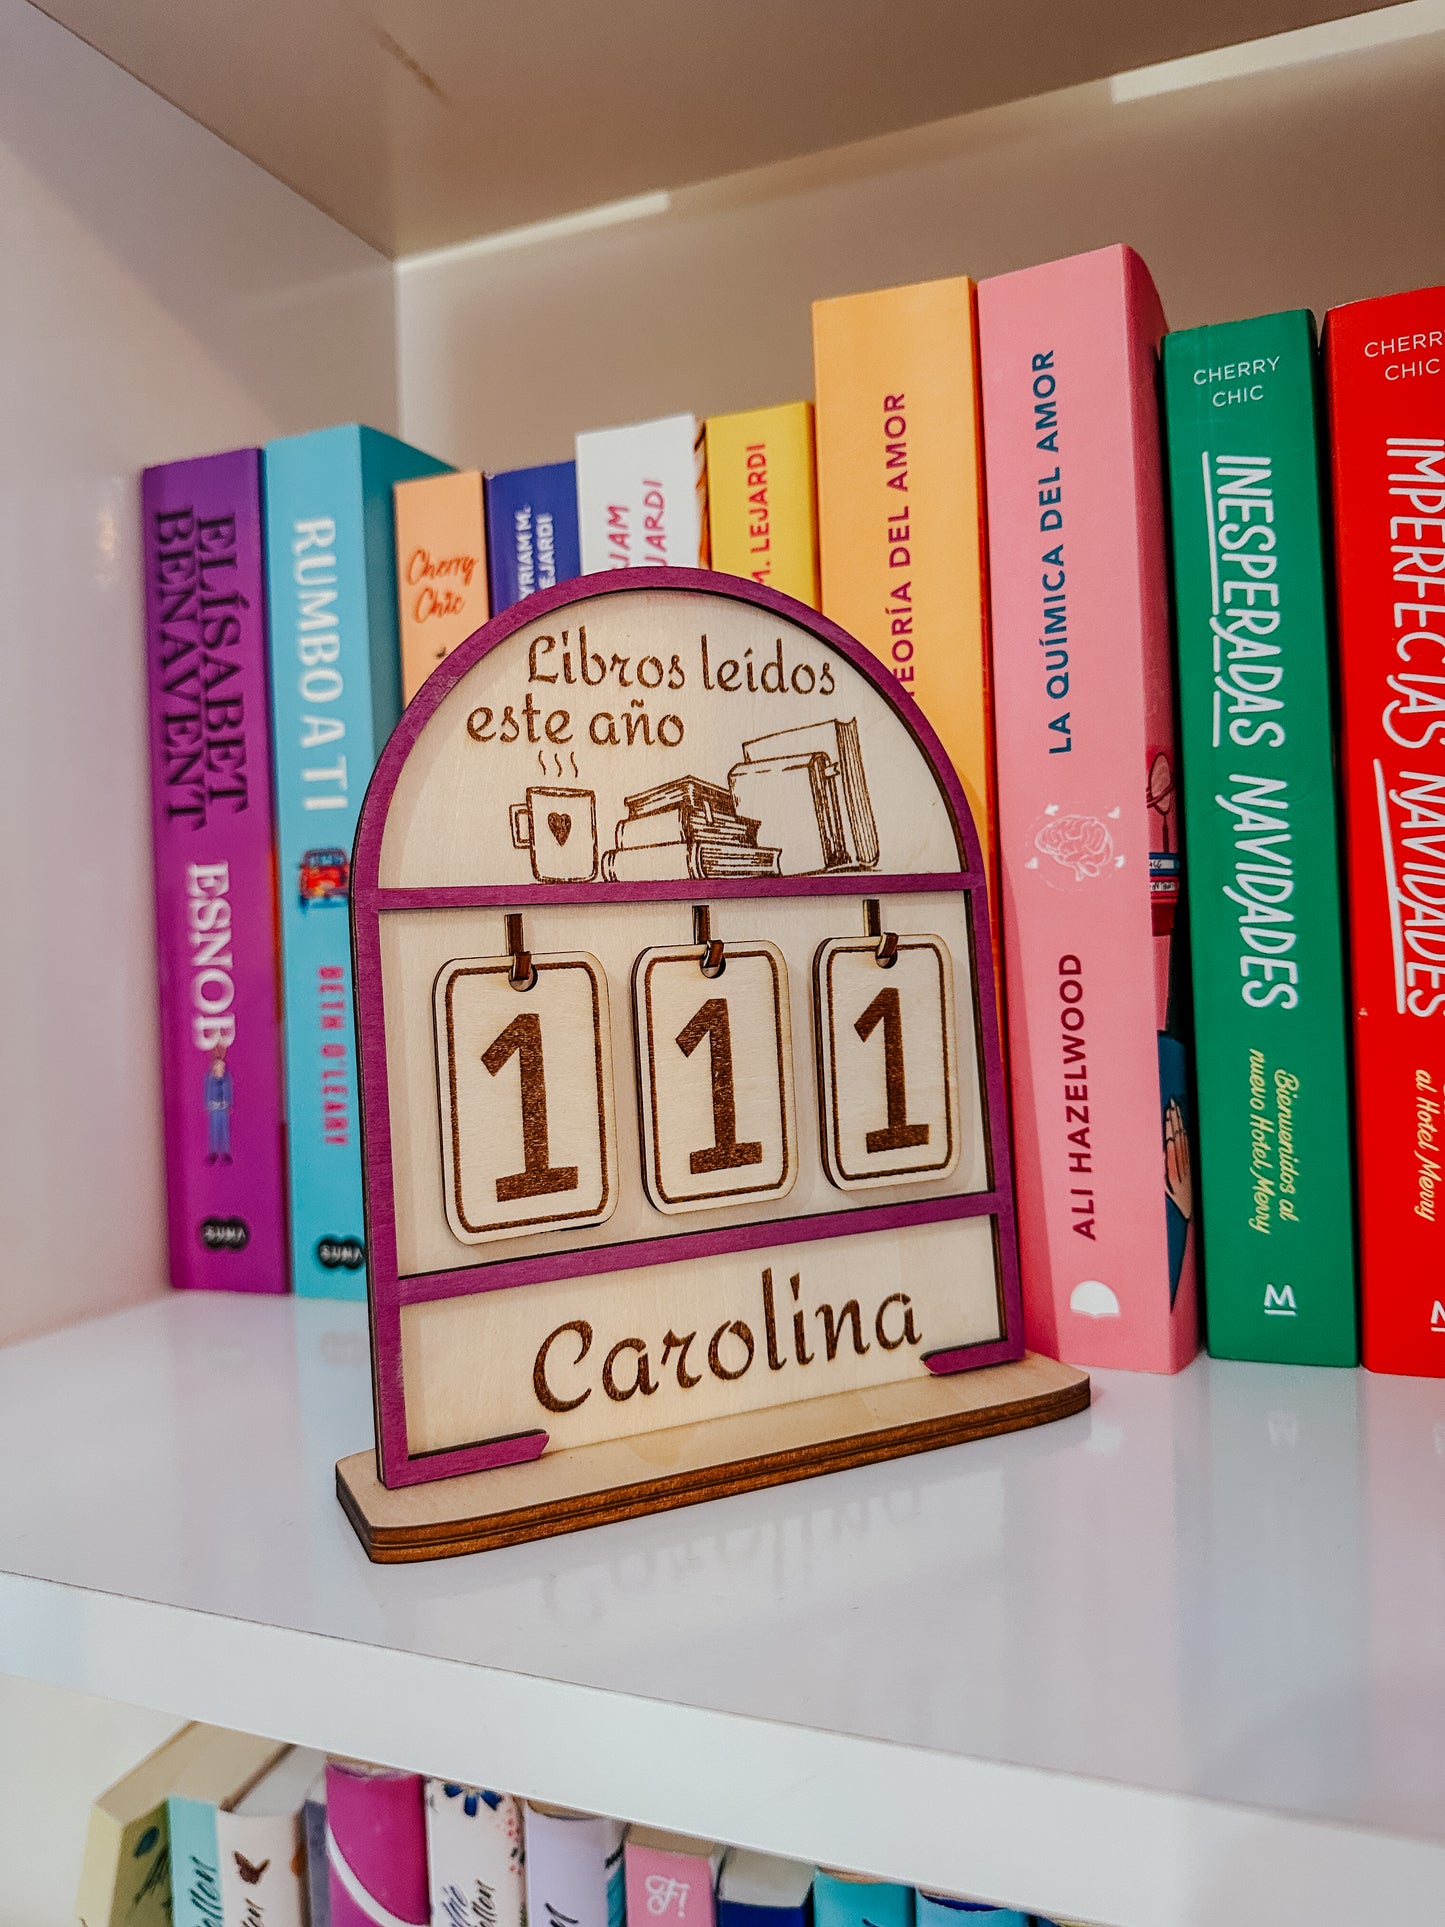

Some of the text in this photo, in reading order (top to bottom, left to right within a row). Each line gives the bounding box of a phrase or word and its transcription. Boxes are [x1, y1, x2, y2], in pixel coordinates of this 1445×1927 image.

[1193, 355, 1281, 386] CHERRY
[1211, 384, 1264, 408] CHIC
[1363, 329, 1445, 358] CHERR
[1385, 357, 1441, 381] CHIC
[405, 548, 478, 587] Cherry
[745, 442, 771, 553] LEJARDI
[883, 393, 915, 697] EORÍA DEL AMOR
[1032, 350, 1072, 754] LA QUÍMICA DEL AMOR
[156, 504, 208, 831] BENAVENT
[197, 512, 250, 813] ELÍSABET
[291, 516, 349, 811] RUMBO A TI
[414, 587, 465, 623] Chic
[526, 626, 836, 697] Libros leídos
[466, 693, 685, 747] este año
[1210, 455, 1299, 1010] INESPERADAS NAVIDADES
[186, 861, 237, 1051] ESNOB
[1058, 952, 1098, 1242] ALI HAZELWOOD
[1248, 1048, 1276, 1235] nuevo Hotel Merry
[1274, 1069, 1300, 1222] Bienvenidos al
[1414, 1069, 1442, 1222] al Hotel Merry
[533, 1266, 923, 1413] Carolina
